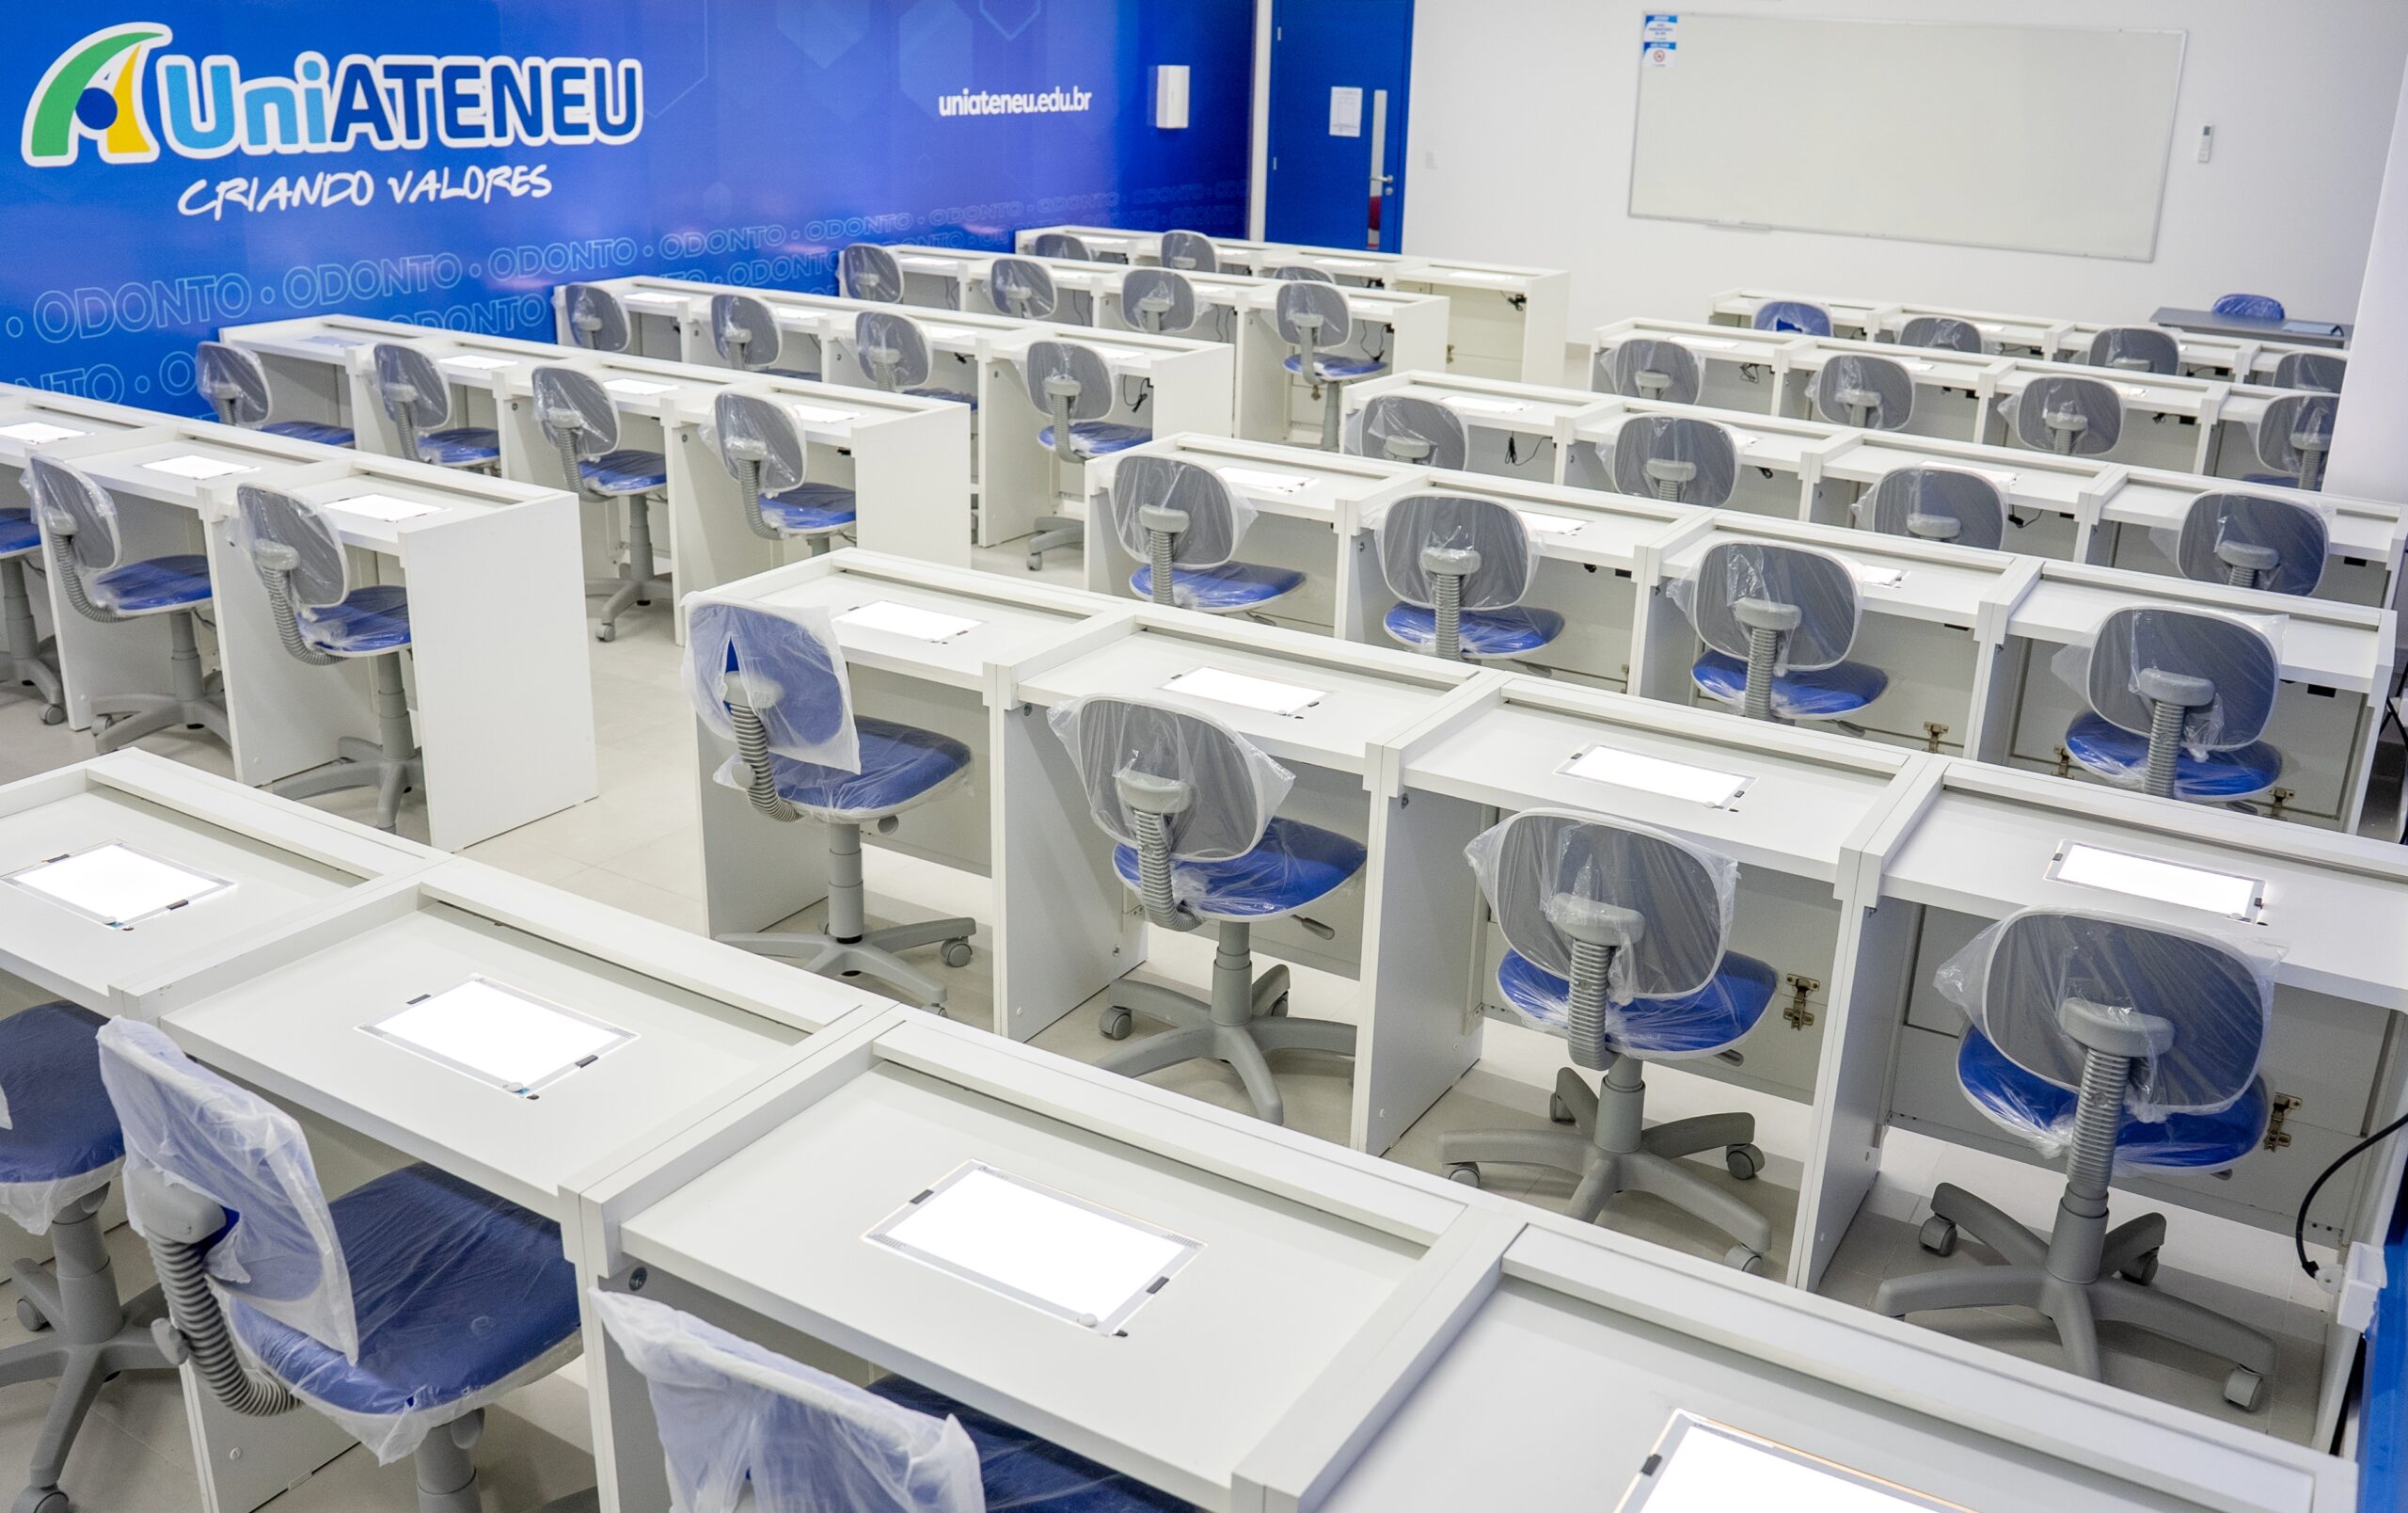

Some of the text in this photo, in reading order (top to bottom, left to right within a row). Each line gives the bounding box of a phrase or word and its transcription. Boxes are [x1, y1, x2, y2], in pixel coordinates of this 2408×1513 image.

[156, 51, 643, 159] UniATENEU
[939, 86, 1092, 117] uniateneu.edu.br
[178, 164, 553, 221] CRIANDO VALORES
[33, 273, 252, 343] ODONTO
[283, 252, 463, 309] ODONTO
[488, 237, 637, 282] ODONTO
[660, 224, 785, 260] ODONTO
[805, 213, 912, 242] ODONTO
[929, 200, 1023, 226] ODONTO
